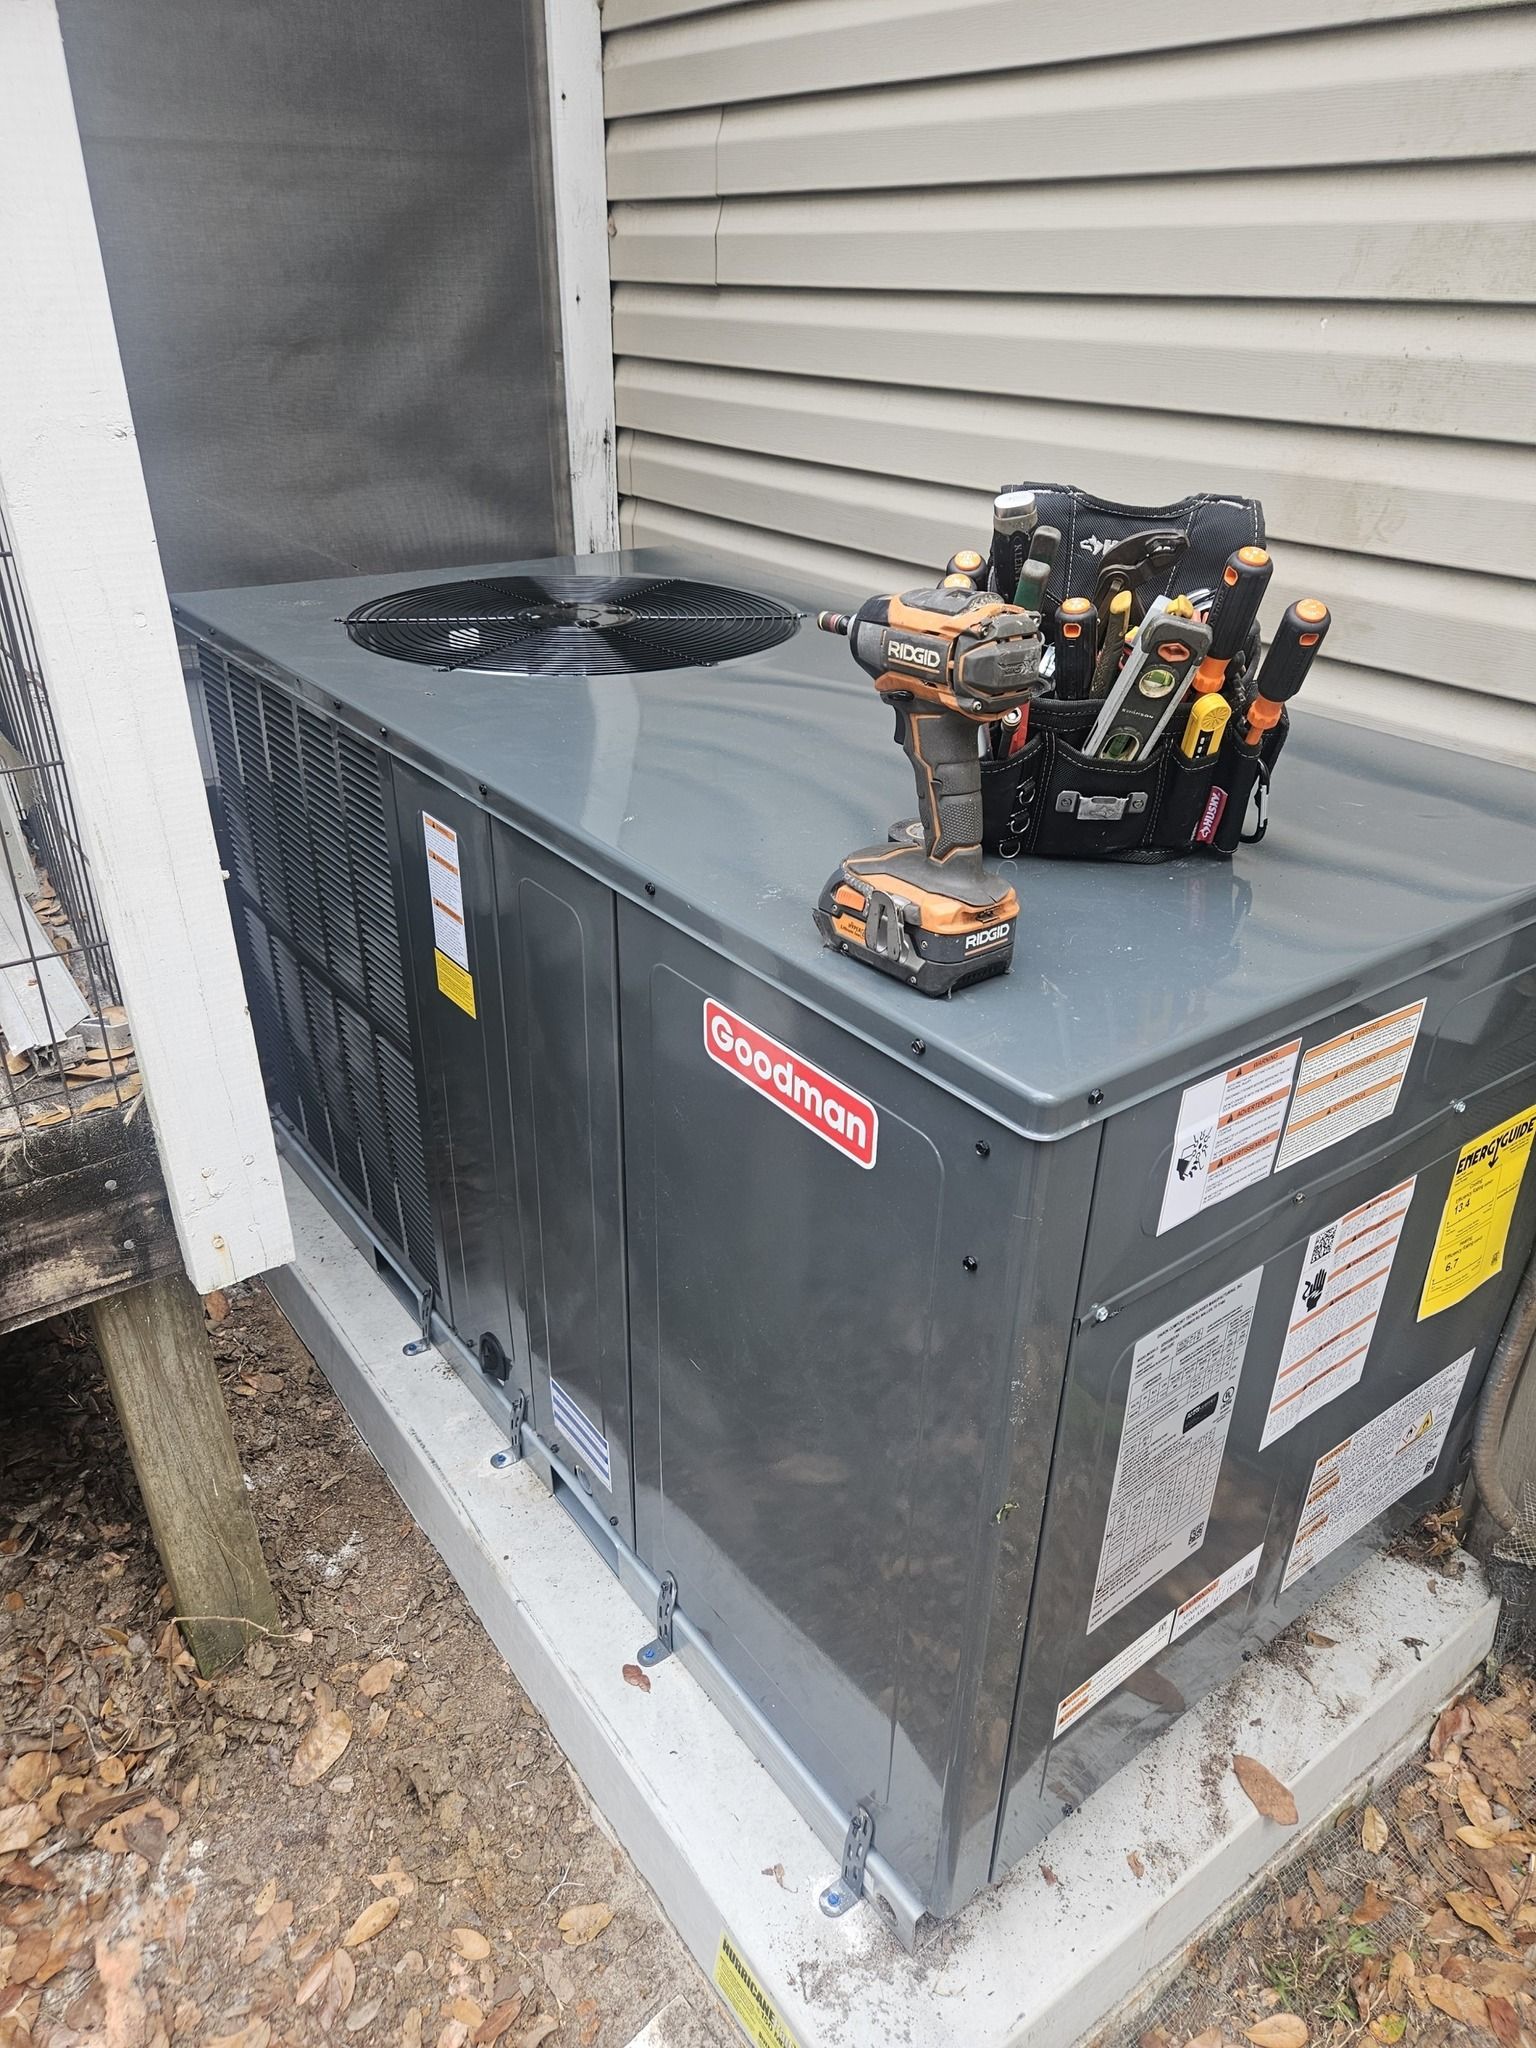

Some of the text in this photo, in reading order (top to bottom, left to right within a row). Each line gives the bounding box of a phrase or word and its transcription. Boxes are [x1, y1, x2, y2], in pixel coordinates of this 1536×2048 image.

[887, 640, 941, 668] RIDGID
[1202, 791, 1221, 827] HUSKY
[965, 923, 1010, 949] RIDGID
[1253, 1052, 1279, 1069] WARNING
[710, 1014, 868, 1150] Goodman
[1237, 1096, 1274, 1117] ADVERTENCIA
[1227, 1136, 1270, 1163] AVERTISSEMENT
[1455, 1198, 1470, 1215] 13.4
[1445, 1258, 1459, 1272] 6.7
[722, 1938, 775, 2022] HURRICANE
